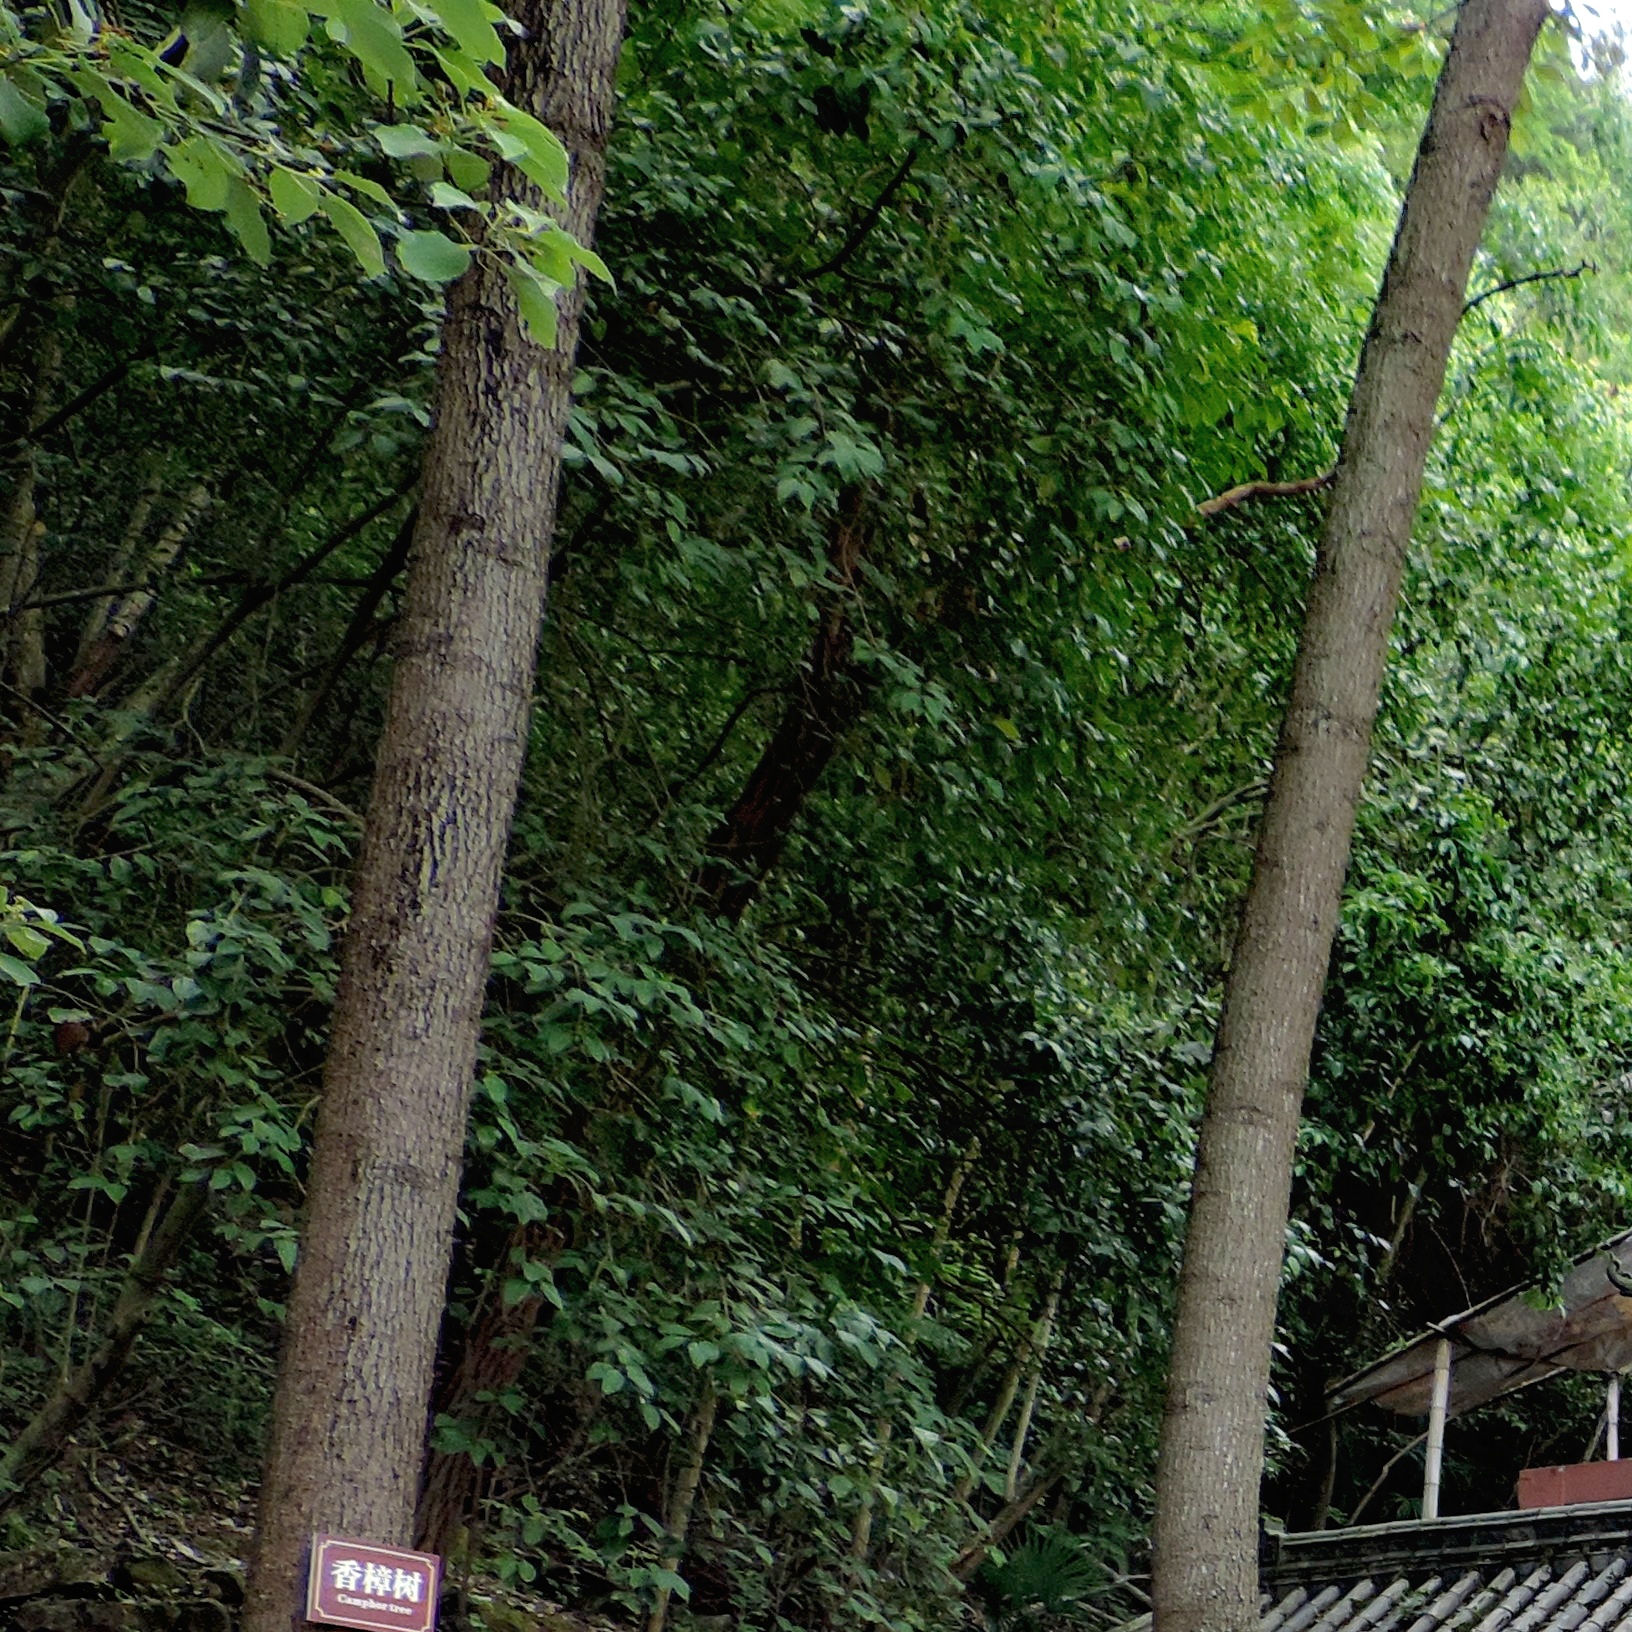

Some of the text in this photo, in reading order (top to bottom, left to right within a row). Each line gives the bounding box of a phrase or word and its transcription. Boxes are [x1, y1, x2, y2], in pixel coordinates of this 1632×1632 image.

[331, 1559, 422, 1603] 香樟树
[337, 1593, 413, 1616] Camphor tree
